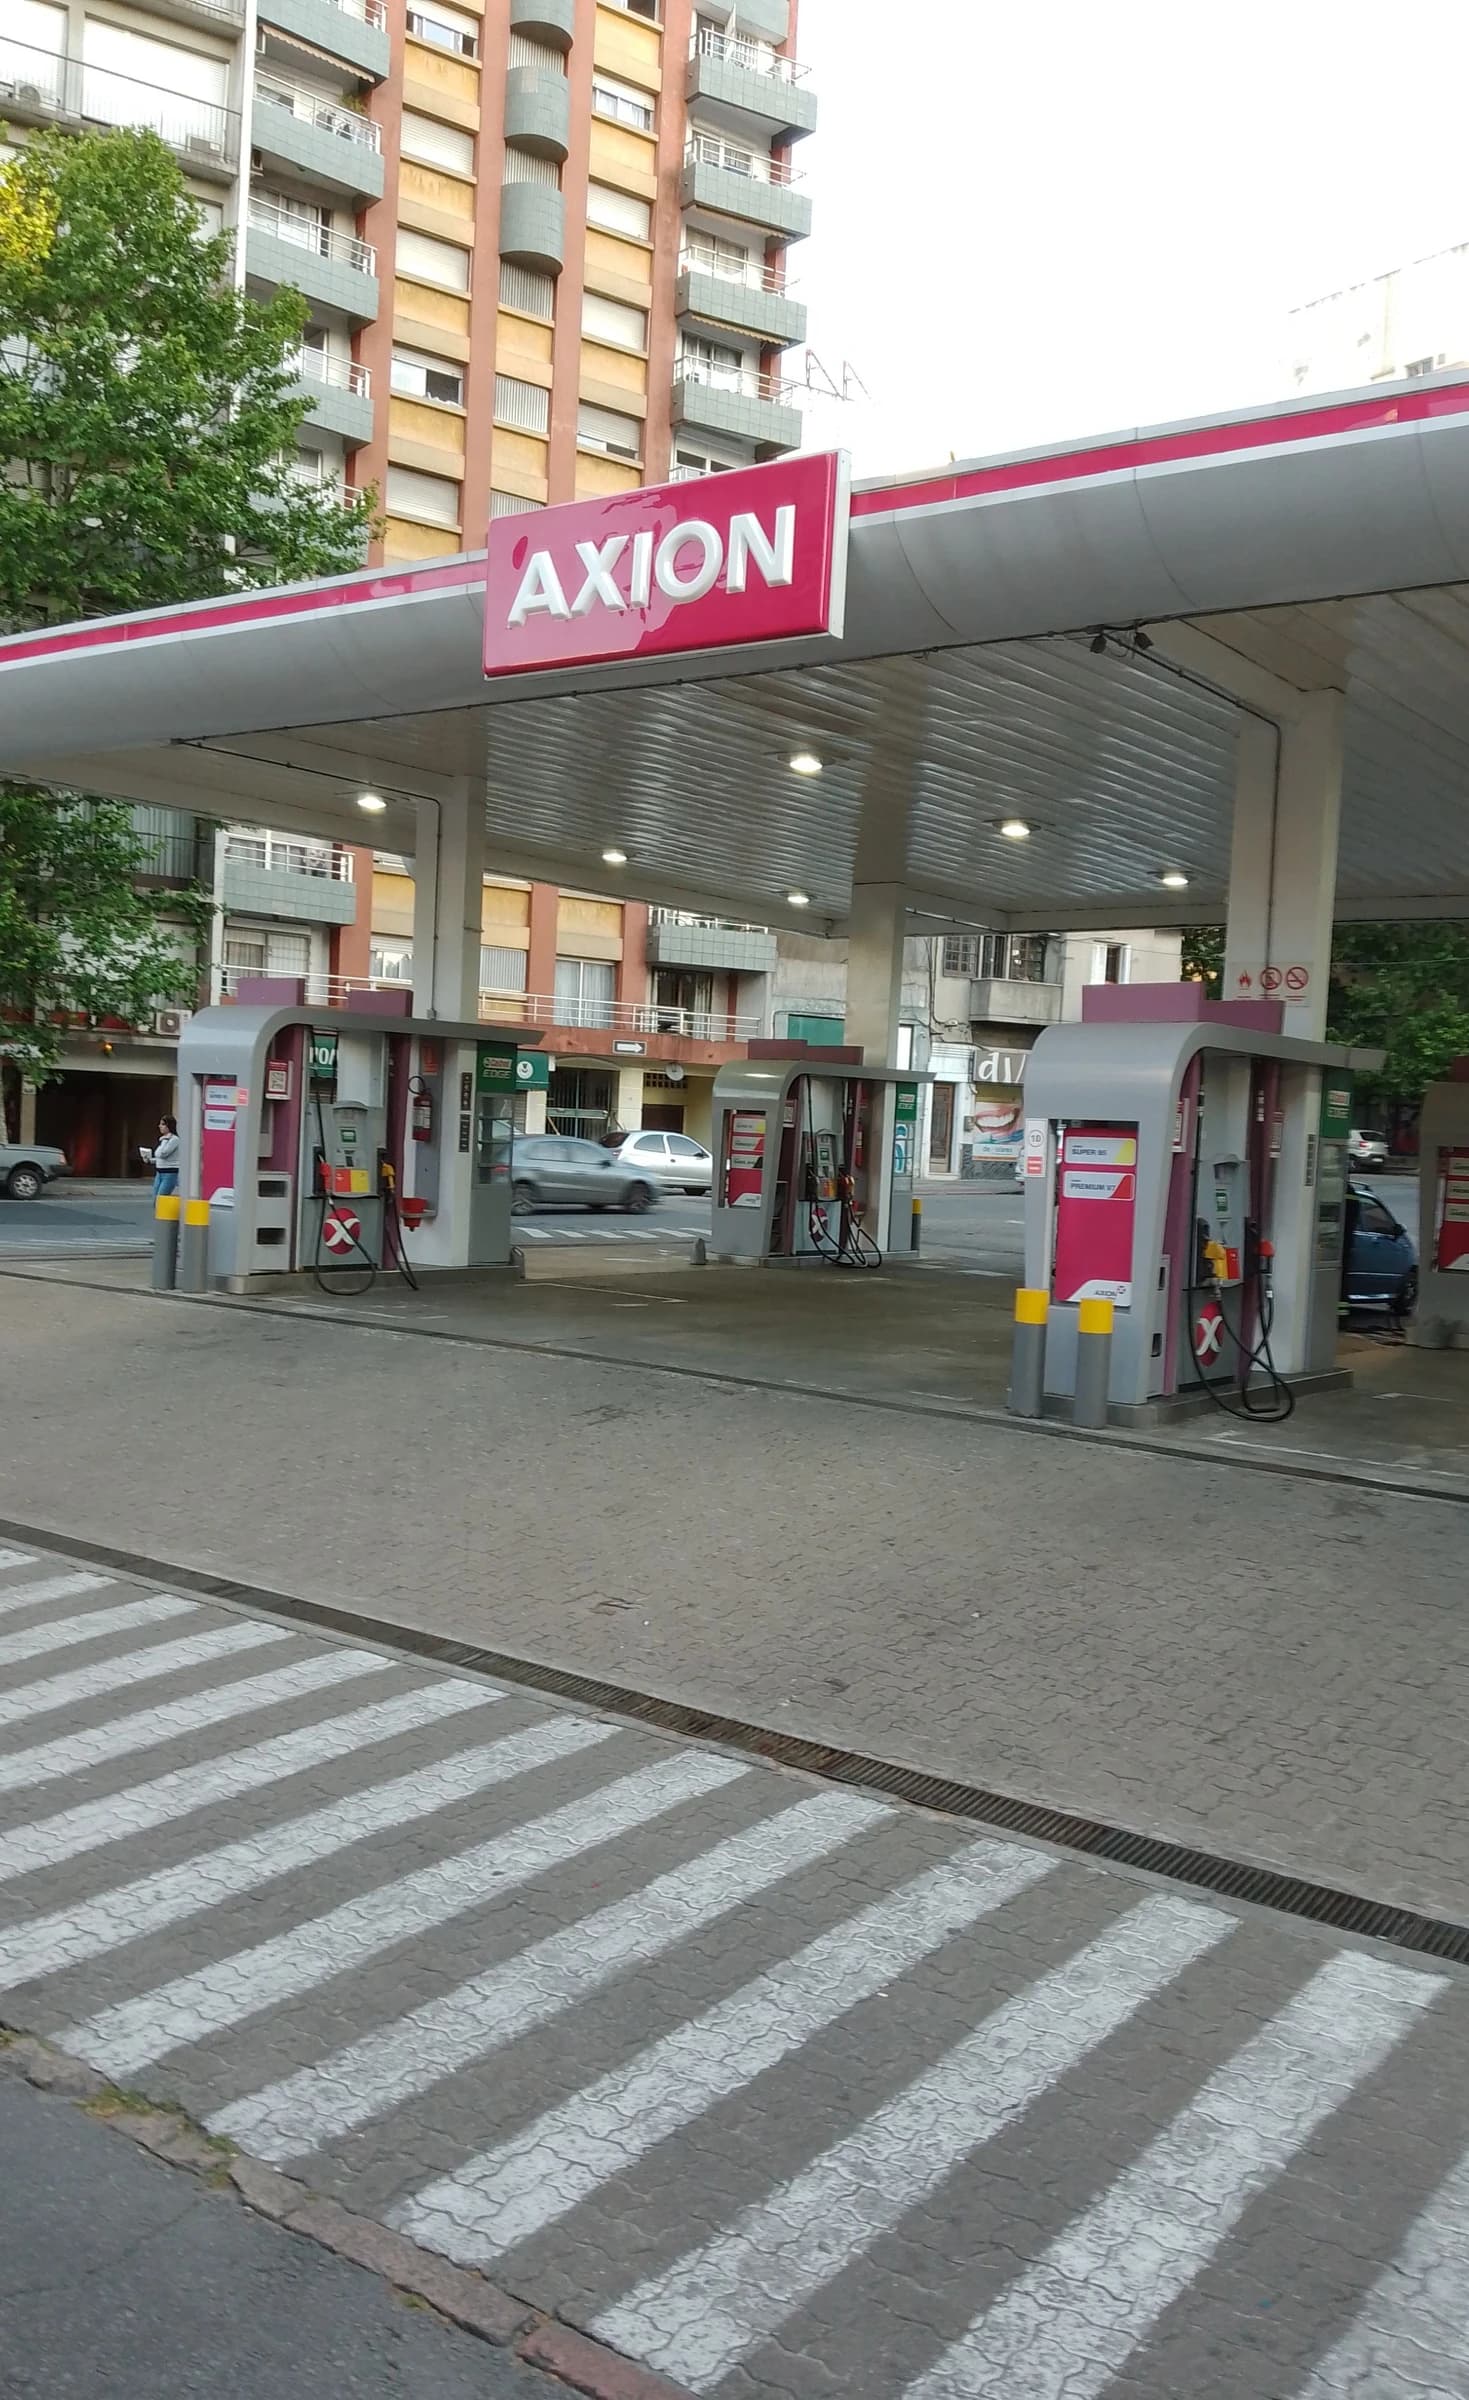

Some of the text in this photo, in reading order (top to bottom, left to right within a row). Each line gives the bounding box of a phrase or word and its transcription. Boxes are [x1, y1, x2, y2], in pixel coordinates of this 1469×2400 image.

[506, 504, 796, 628] AXION
[1071, 1148, 1097, 1156] SUPER
[1070, 1182, 1106, 1191] PREMIUM
